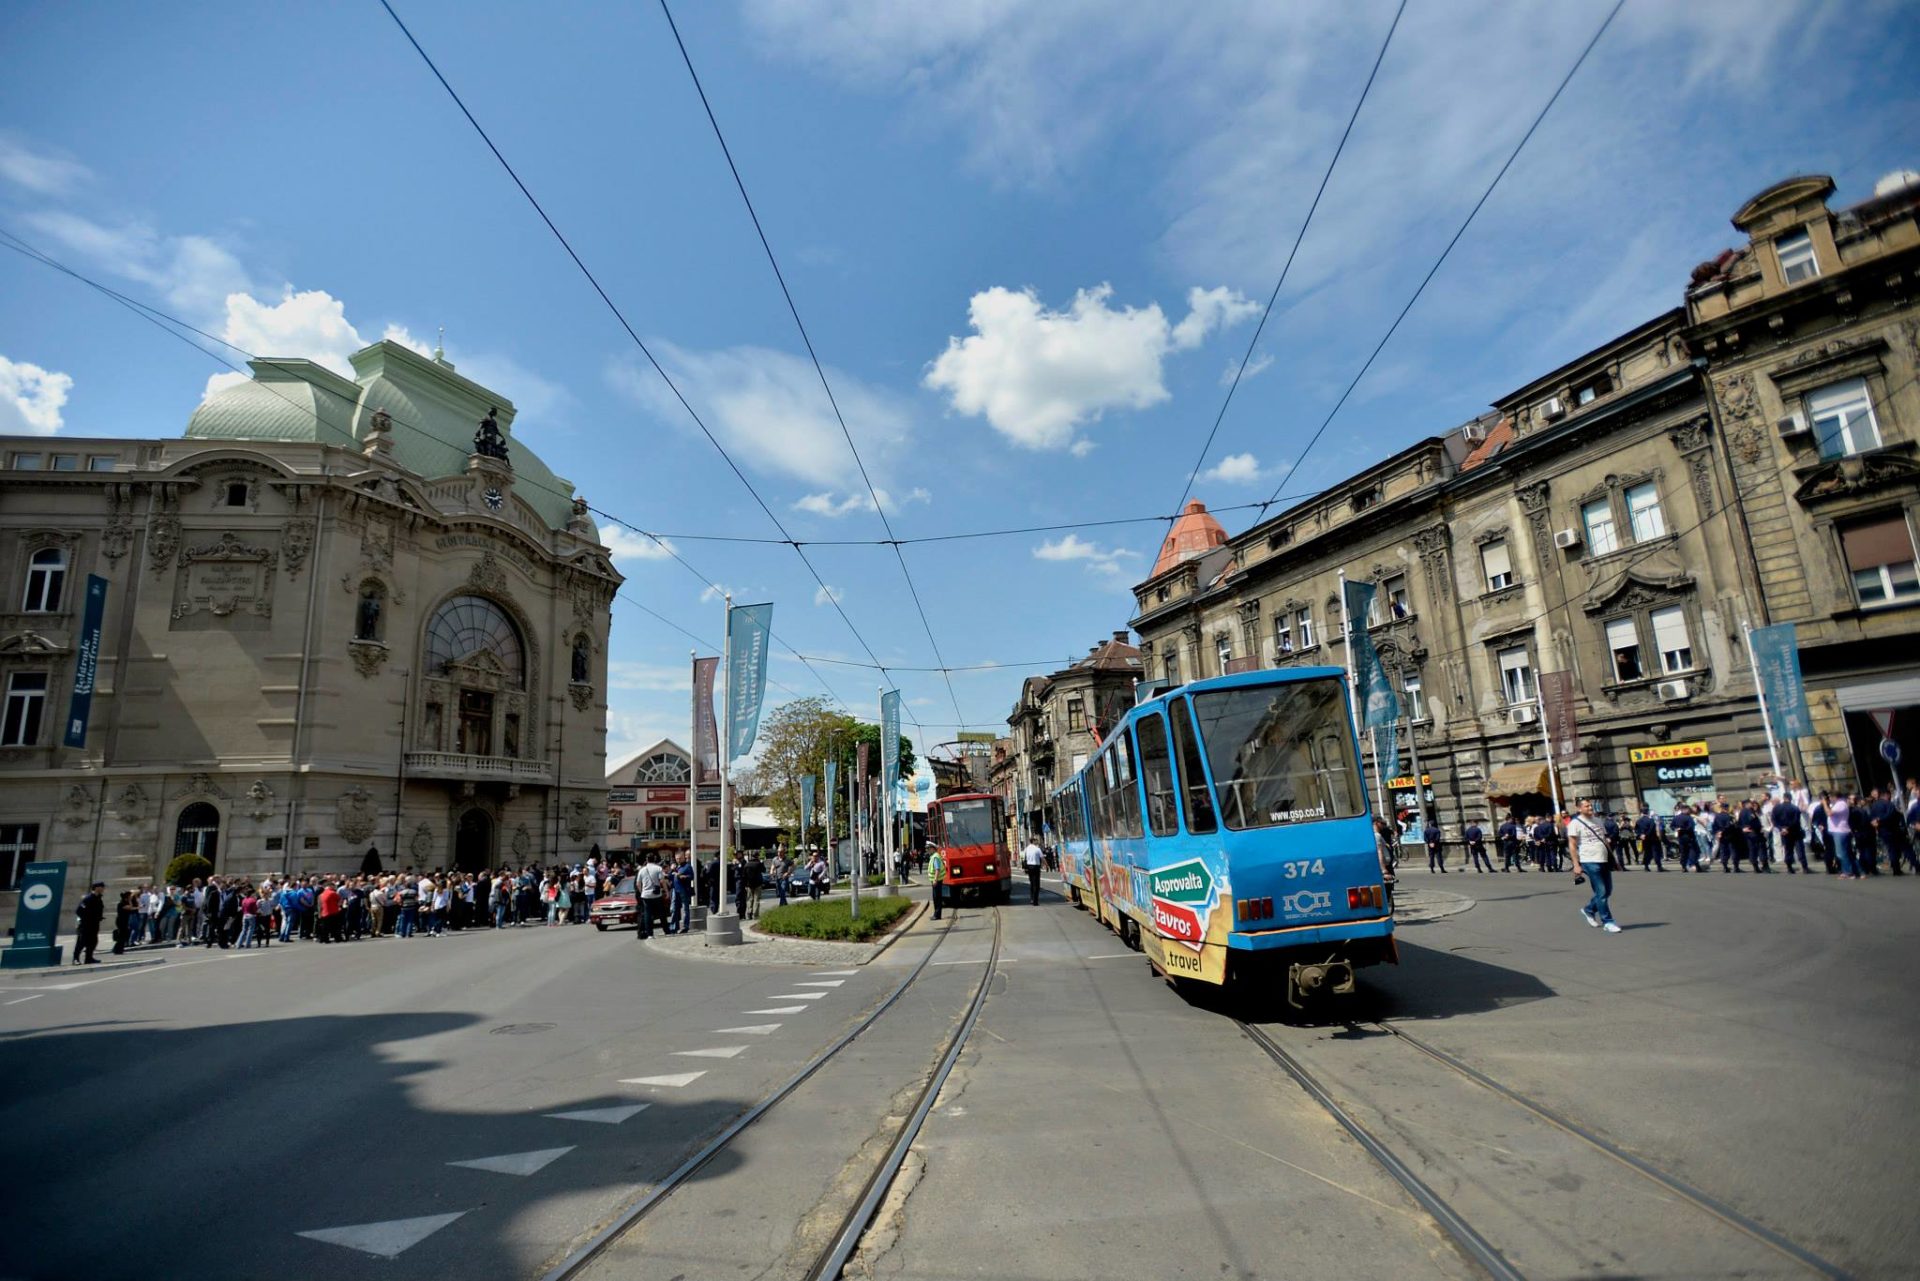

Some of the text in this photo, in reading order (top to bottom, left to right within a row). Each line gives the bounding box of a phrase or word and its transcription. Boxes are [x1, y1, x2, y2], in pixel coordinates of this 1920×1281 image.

[82, 629, 100, 694] Waterfront
[747, 631, 761, 720] Waterfront
[1644, 746, 1704, 760] Morso
[1657, 763, 1712, 780] Ceresit
[1283, 859, 1326, 879] 374
[1155, 872, 1203, 897] Asprovalta
[1166, 951, 1202, 973] .travel
